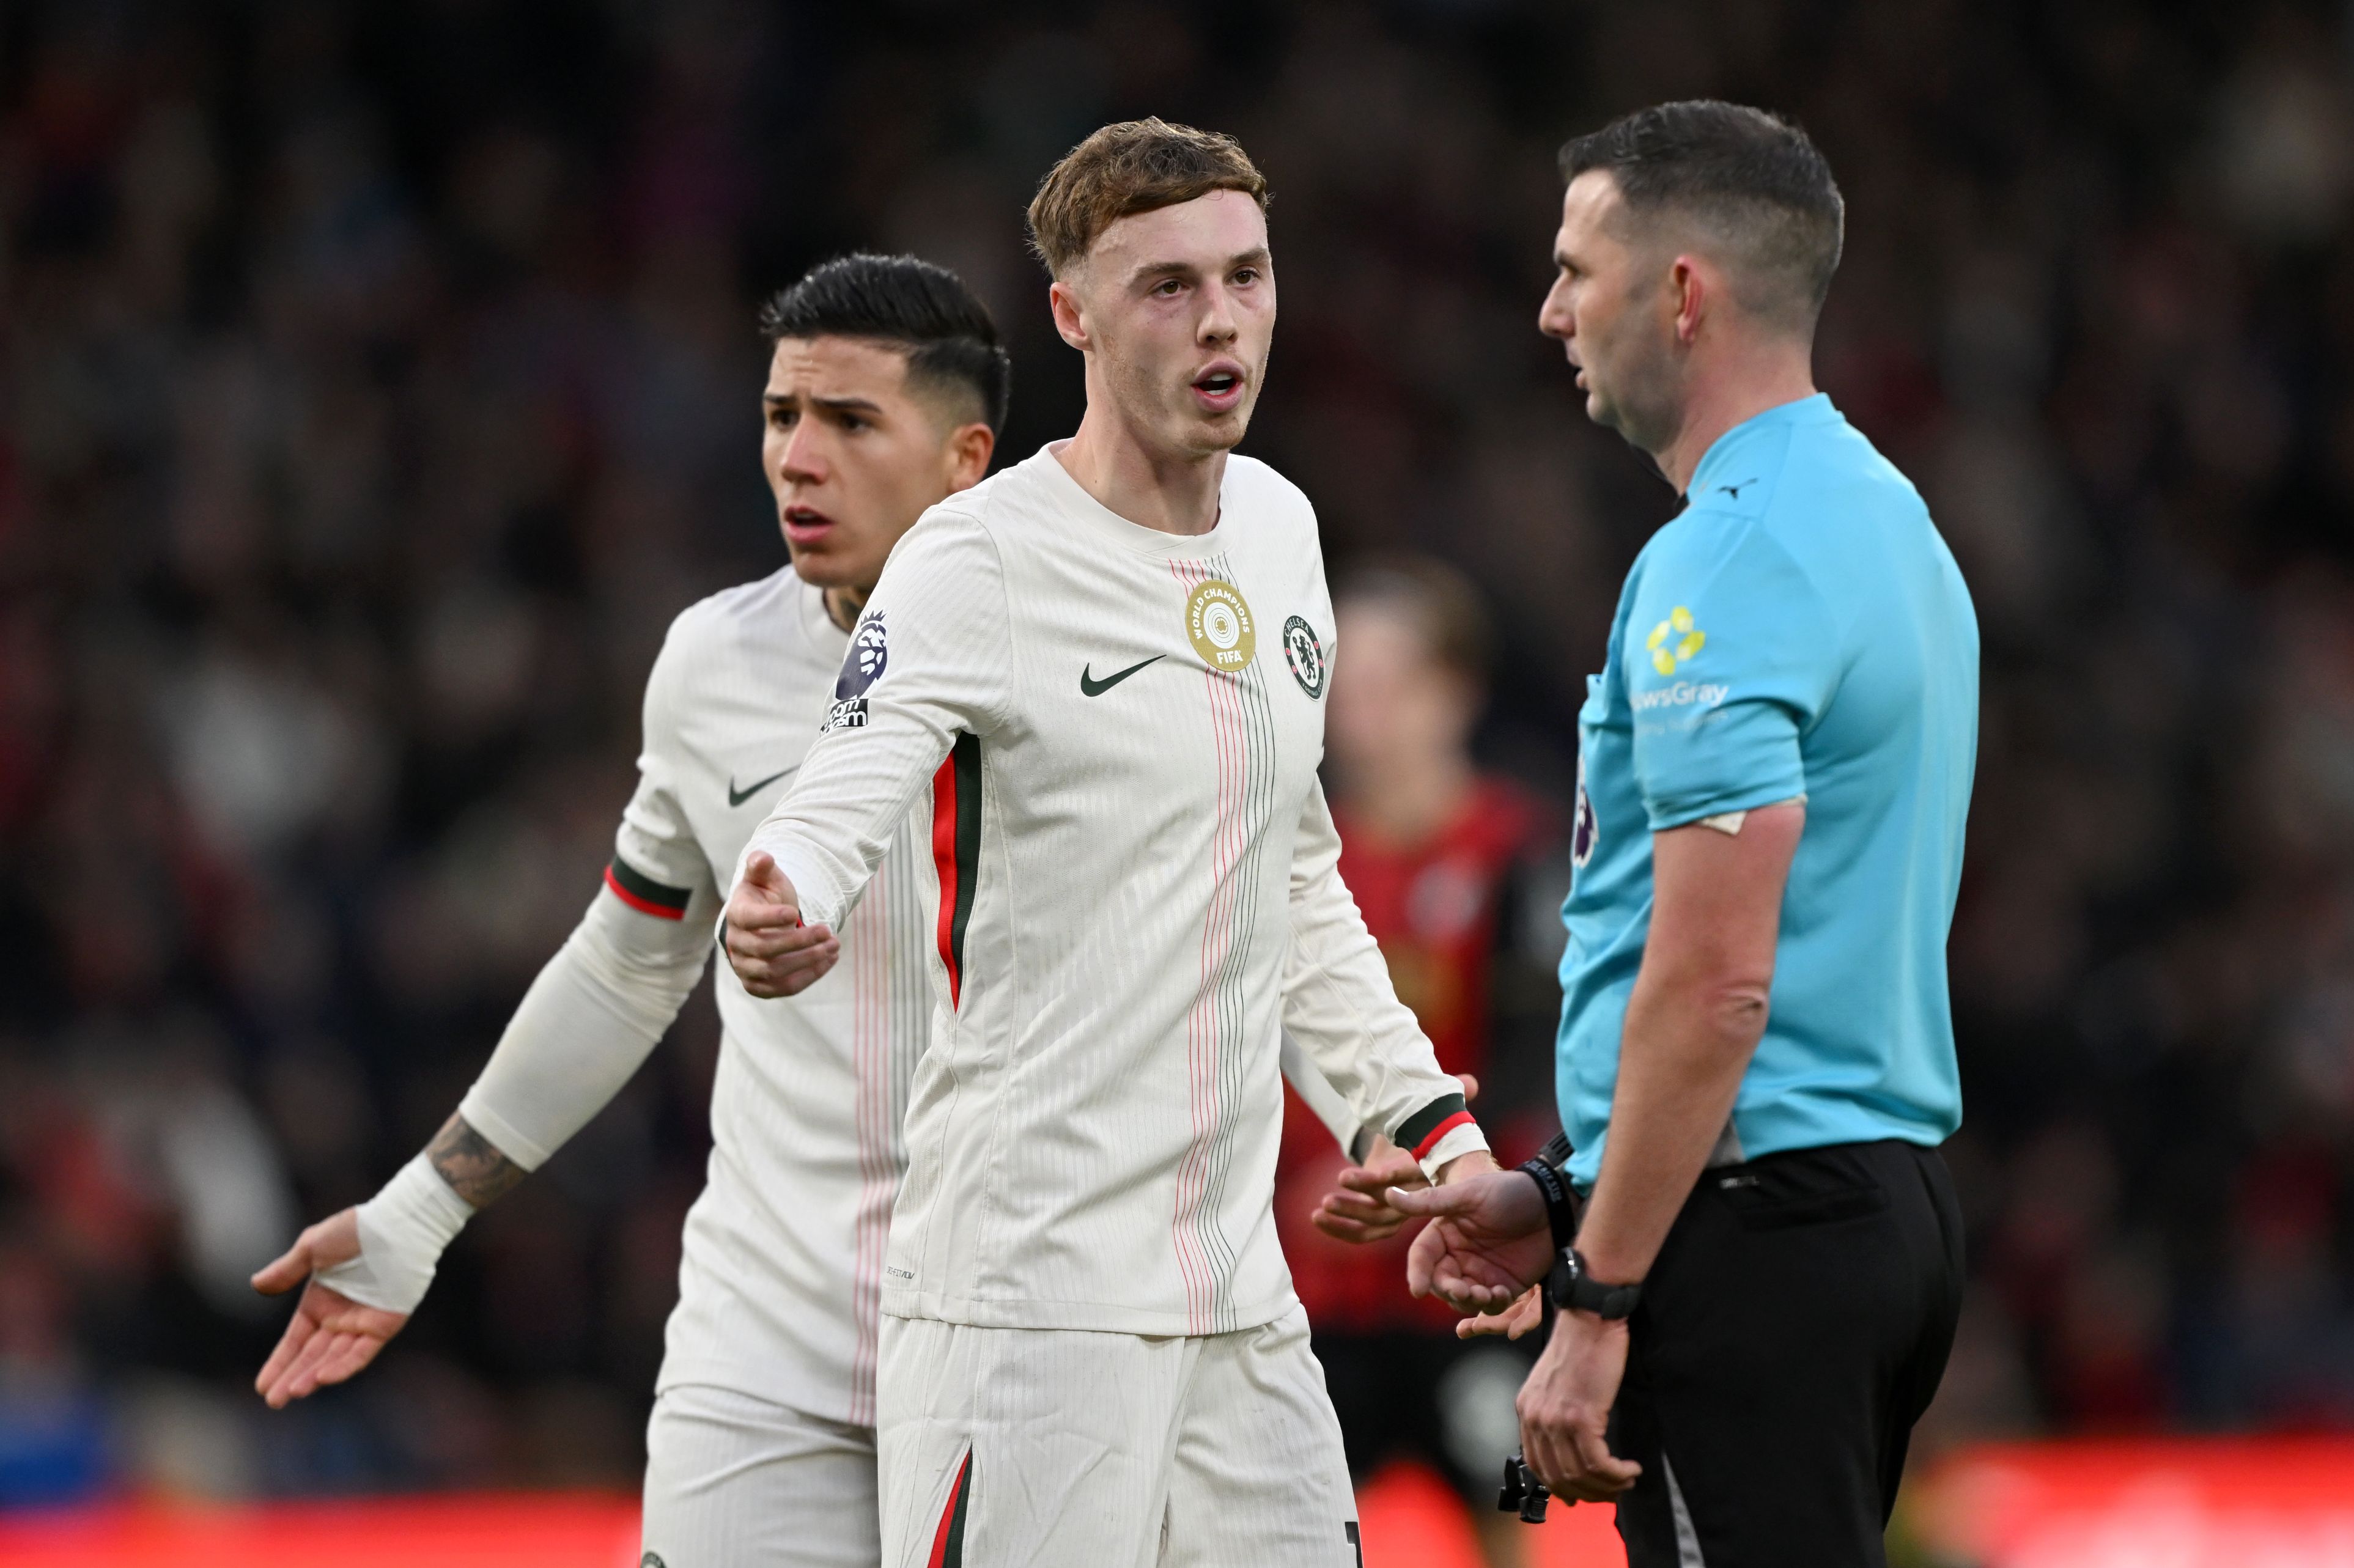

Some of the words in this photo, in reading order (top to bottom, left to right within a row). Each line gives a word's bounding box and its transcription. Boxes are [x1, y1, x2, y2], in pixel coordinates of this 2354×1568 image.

[1192, 597, 1205, 639] WORLD
[1204, 588, 1250, 634] CHAMPIONS
[1284, 617, 1309, 637] CHELSEA
[1216, 650, 1243, 664] FIFA
